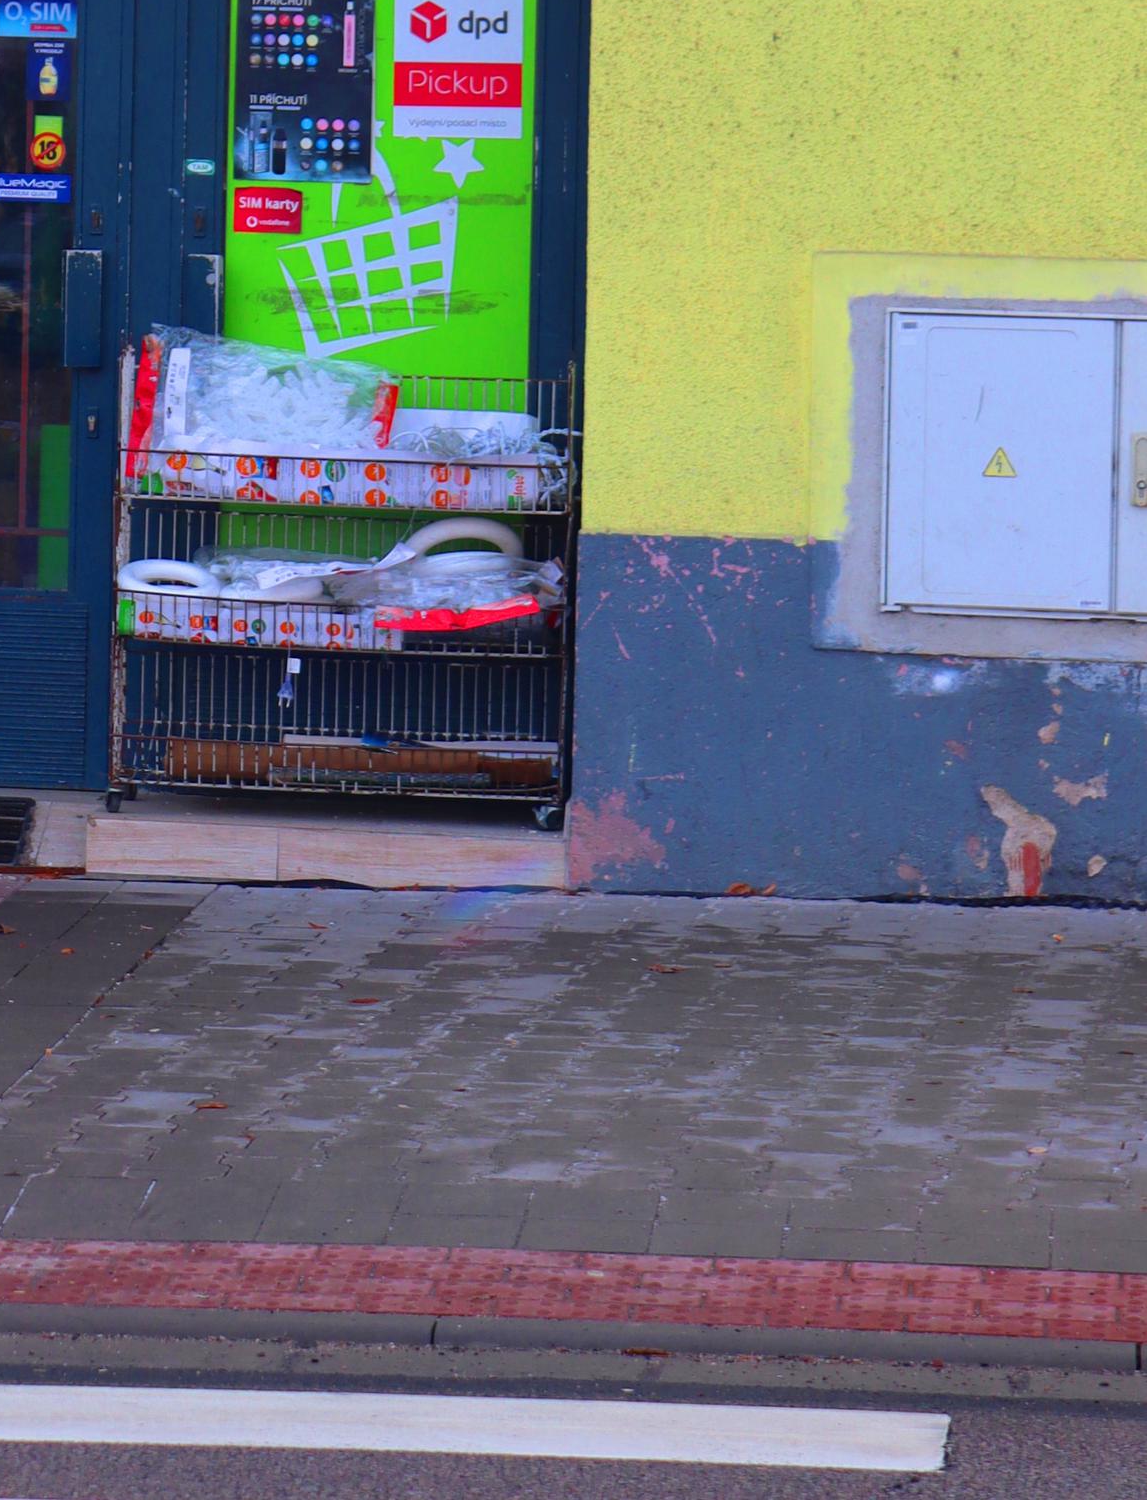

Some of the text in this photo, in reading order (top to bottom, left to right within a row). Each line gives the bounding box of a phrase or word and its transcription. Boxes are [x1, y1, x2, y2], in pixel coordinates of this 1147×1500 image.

[30, 2, 72, 22] SIM
[458, 10, 508, 40] dpd
[408, 69, 508, 100] Pickup
[239, 196, 300, 213] SIM karty
